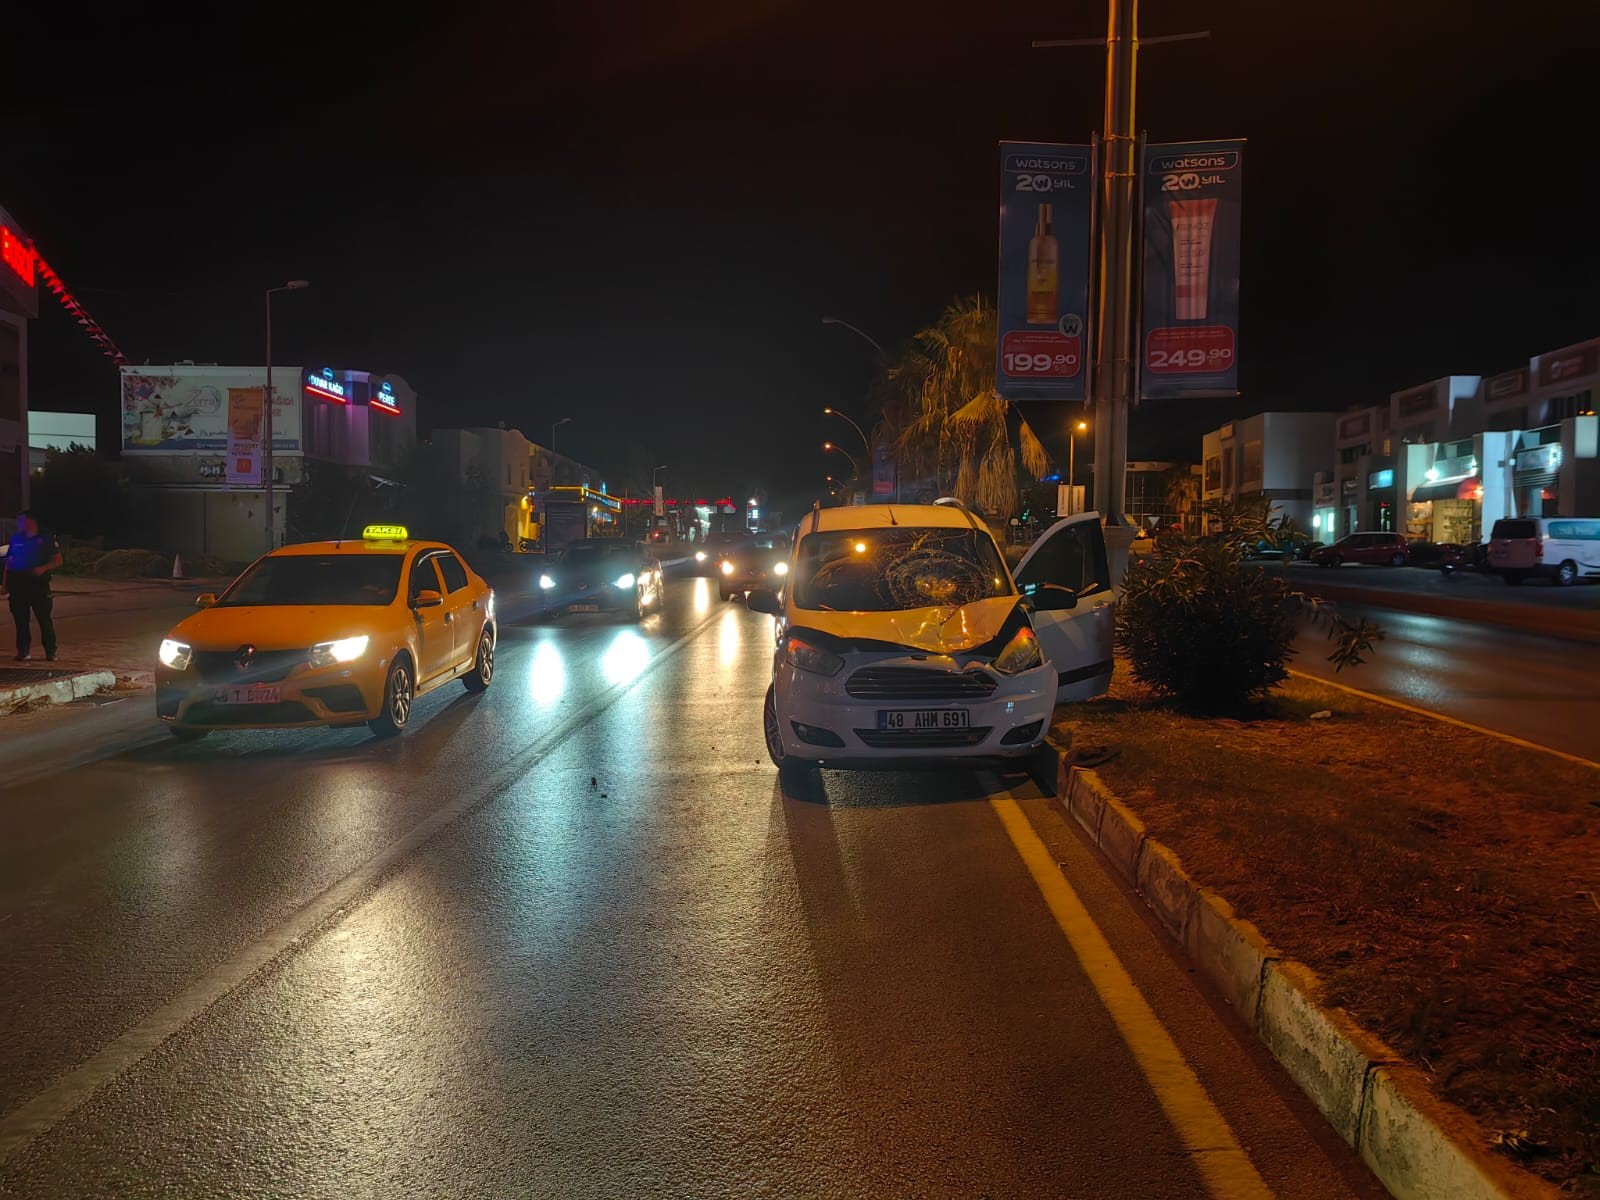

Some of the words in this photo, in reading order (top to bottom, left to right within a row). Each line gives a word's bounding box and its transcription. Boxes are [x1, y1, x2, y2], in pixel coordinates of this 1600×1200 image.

[1015, 158, 1076, 170] watsons
[1161, 157, 1225, 169] watsons
[888, 712, 903, 727] 48
[914, 711, 939, 727] AHM
[943, 711, 967, 727] 691
